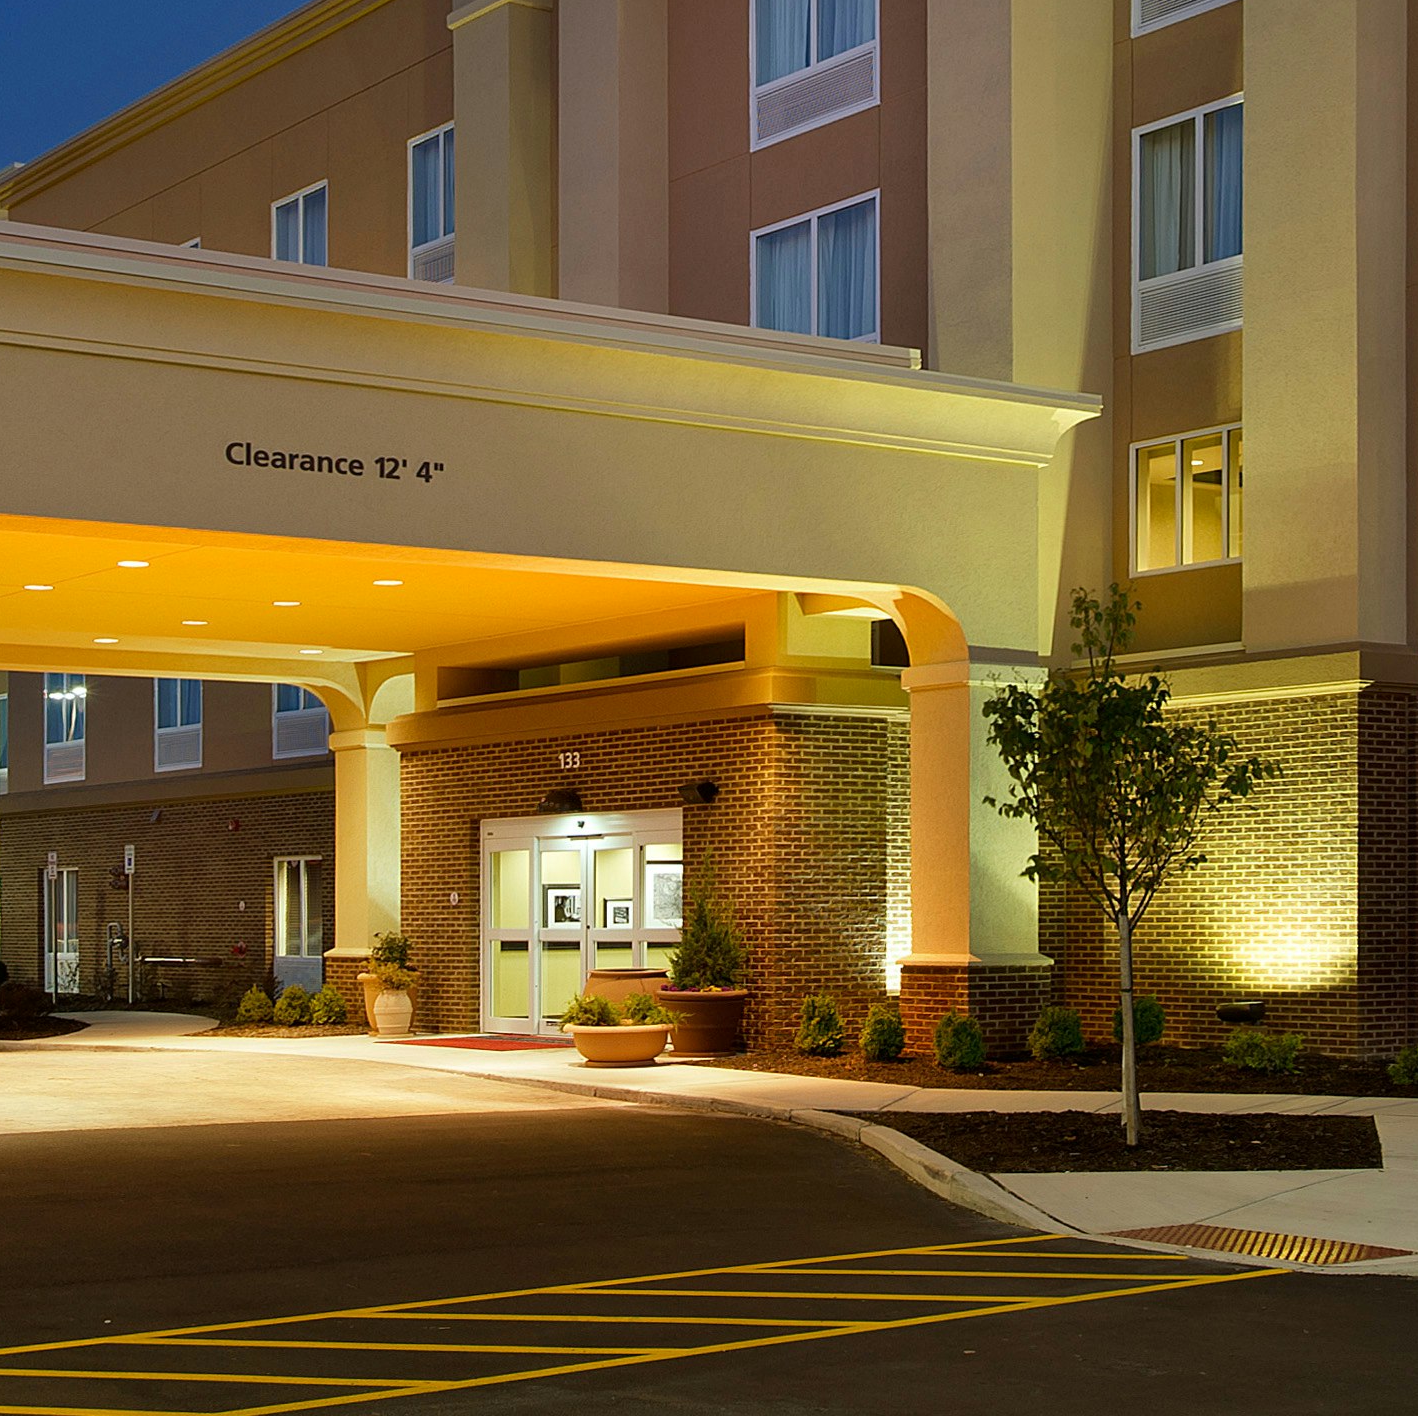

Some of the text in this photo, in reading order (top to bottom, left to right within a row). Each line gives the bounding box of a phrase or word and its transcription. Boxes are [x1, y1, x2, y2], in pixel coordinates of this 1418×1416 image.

[225, 441, 444, 484] Clearance 12' 4"
[558, 751, 580, 769] 133
